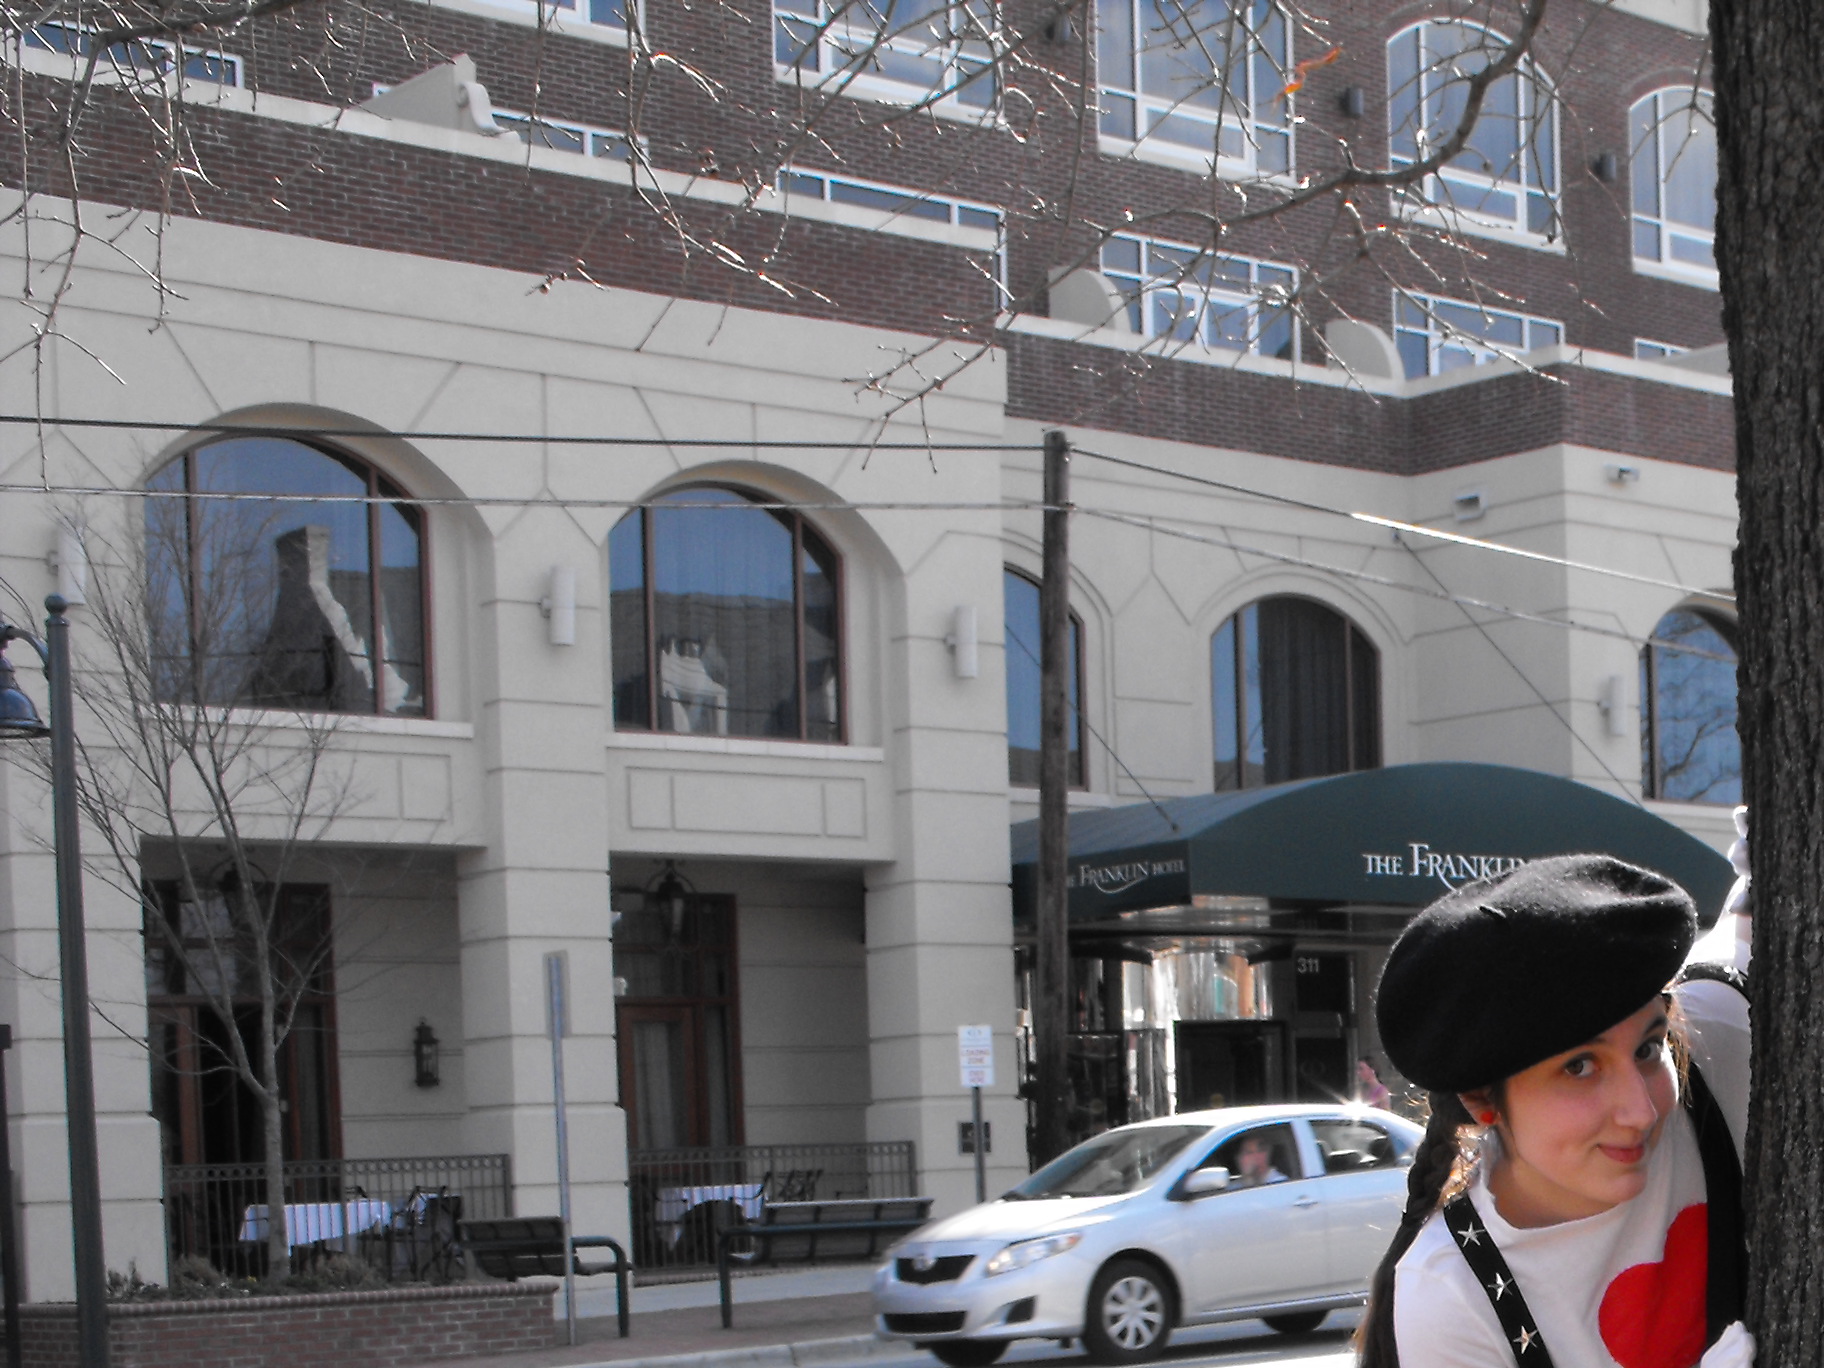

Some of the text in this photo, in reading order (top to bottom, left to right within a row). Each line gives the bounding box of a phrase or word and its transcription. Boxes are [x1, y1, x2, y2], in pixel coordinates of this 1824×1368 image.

[1079, 861, 1149, 893] FRANKLIN
[1152, 859, 1186, 875] HOTEL
[1362, 853, 1404, 876] THE
[1297, 957, 1320, 974] 311
